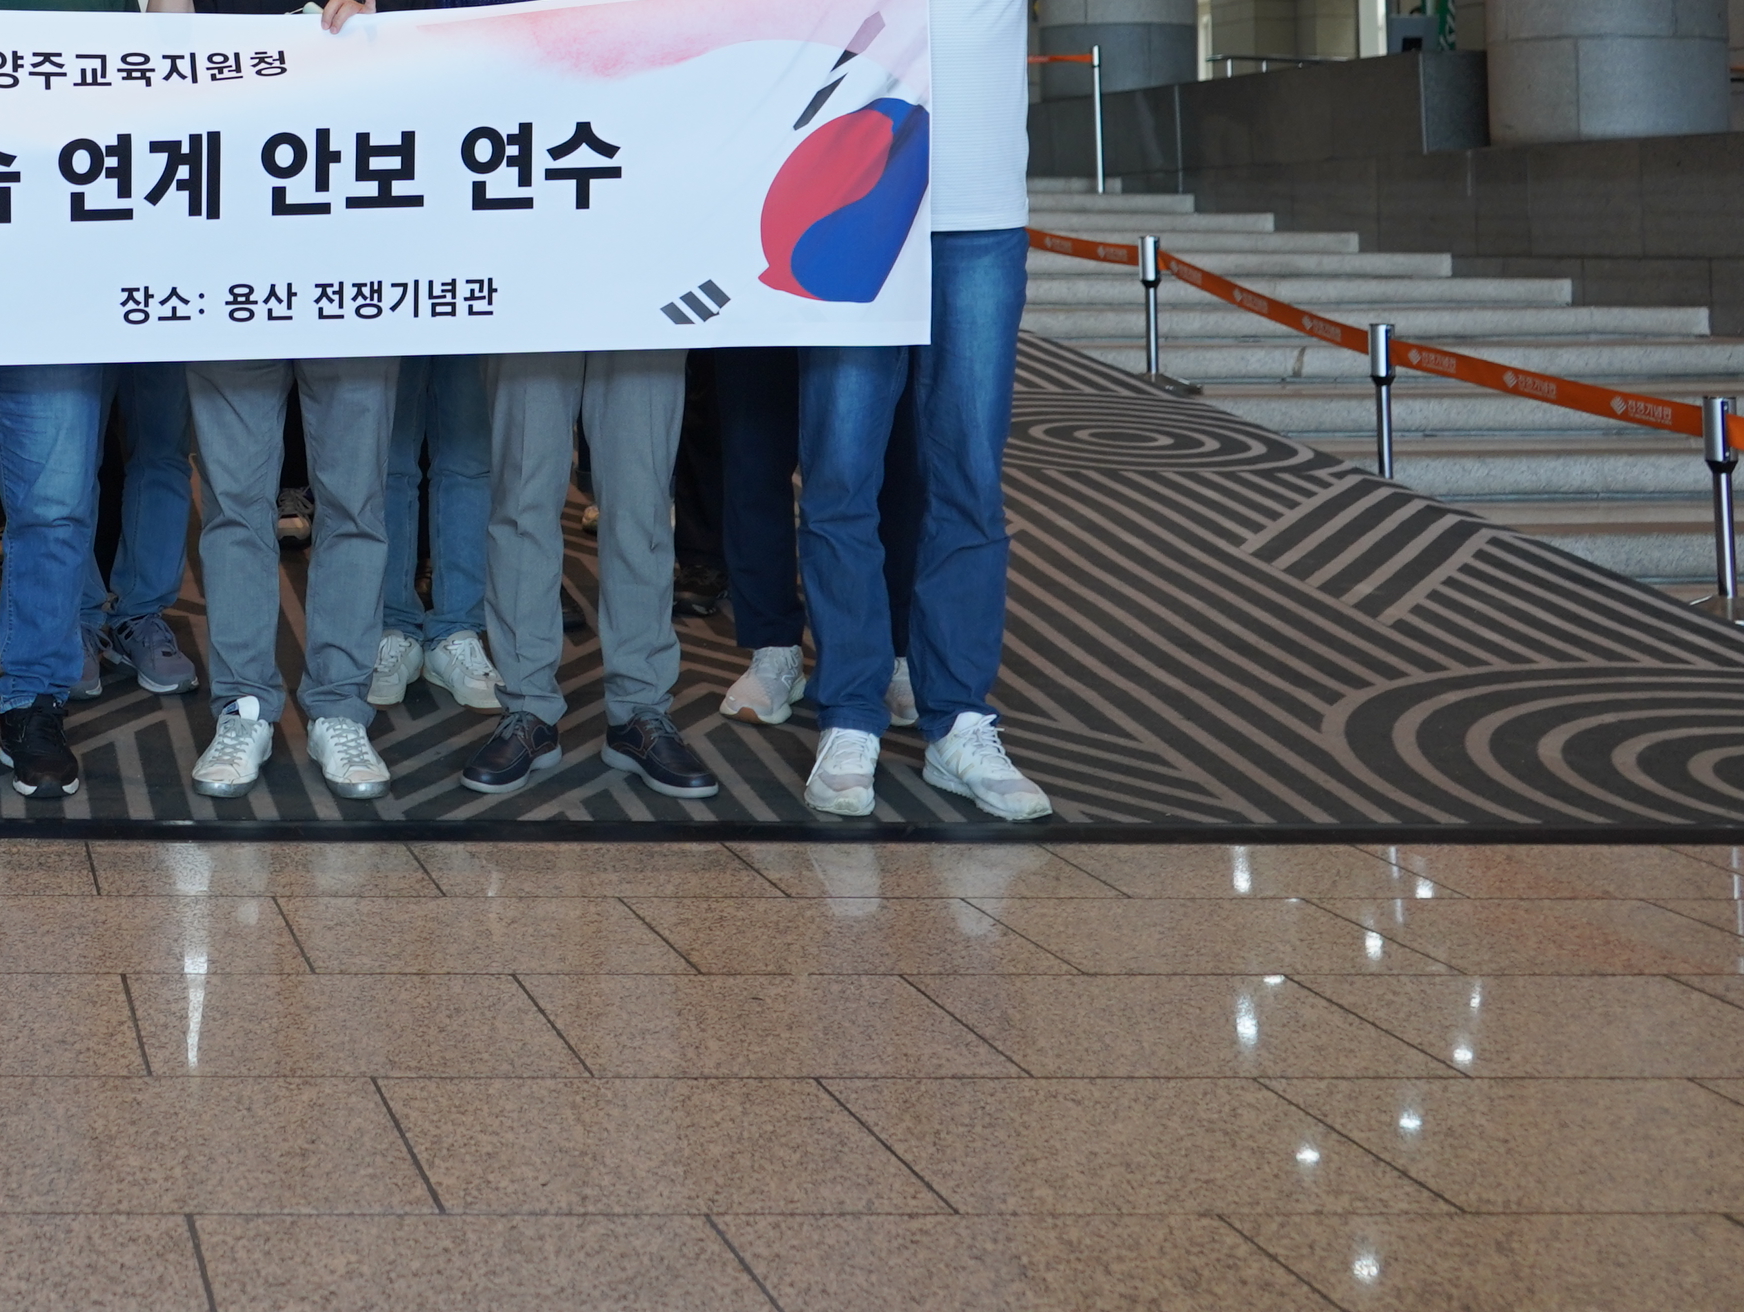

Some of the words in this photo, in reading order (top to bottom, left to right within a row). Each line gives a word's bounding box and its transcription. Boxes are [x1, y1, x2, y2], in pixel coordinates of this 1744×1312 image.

[57, 130, 221, 222] 연계
[260, 127, 425, 217] 안보
[460, 121, 622, 211] 연수
[119, 285, 205, 325] 장소:
[224, 282, 298, 323] 용산
[313, 277, 498, 320] 전쟁기념관
